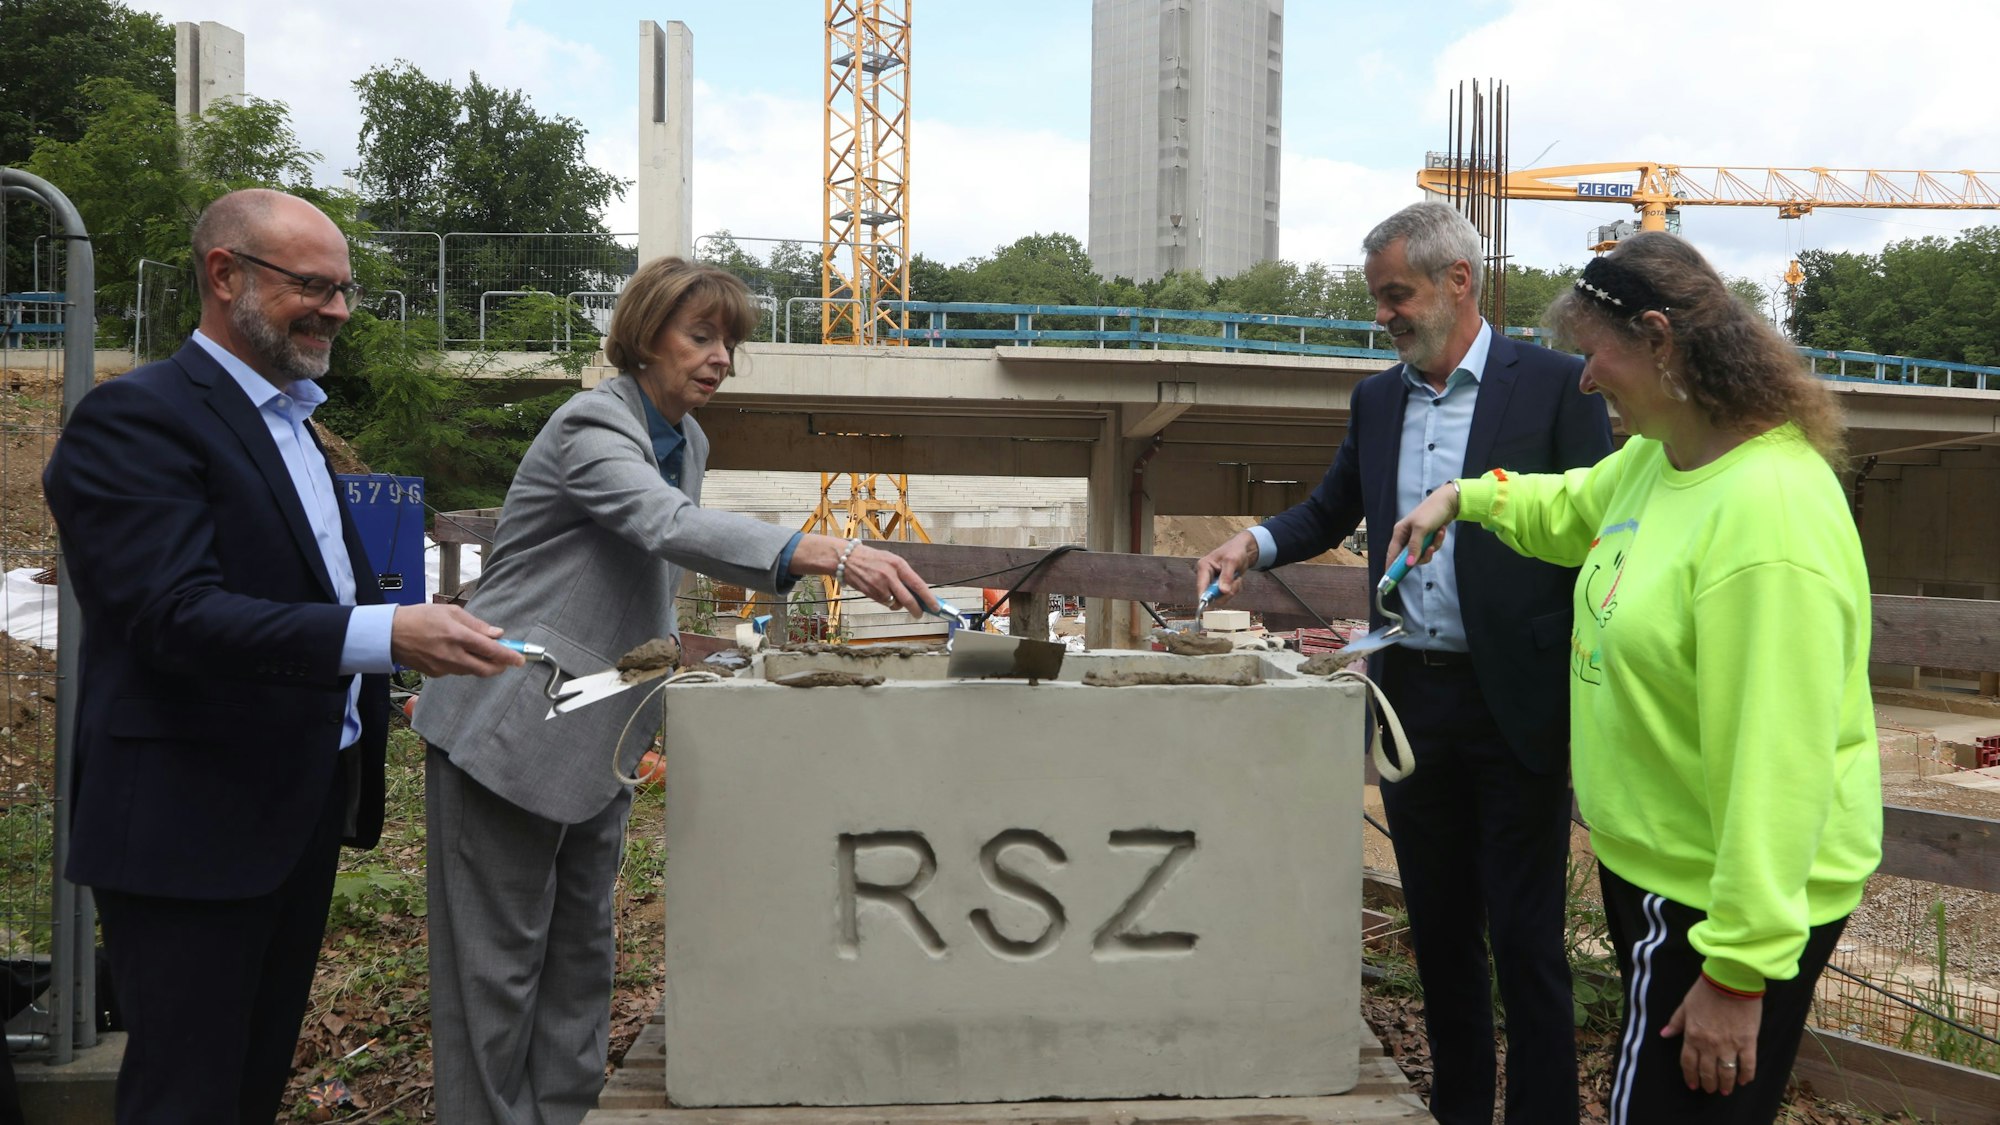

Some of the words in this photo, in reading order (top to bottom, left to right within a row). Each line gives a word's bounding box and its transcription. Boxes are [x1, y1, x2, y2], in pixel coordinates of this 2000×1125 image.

[1580, 184, 1631, 196] ZECH
[348, 482, 421, 504] 5796
[836, 828, 1199, 961] RSZ
